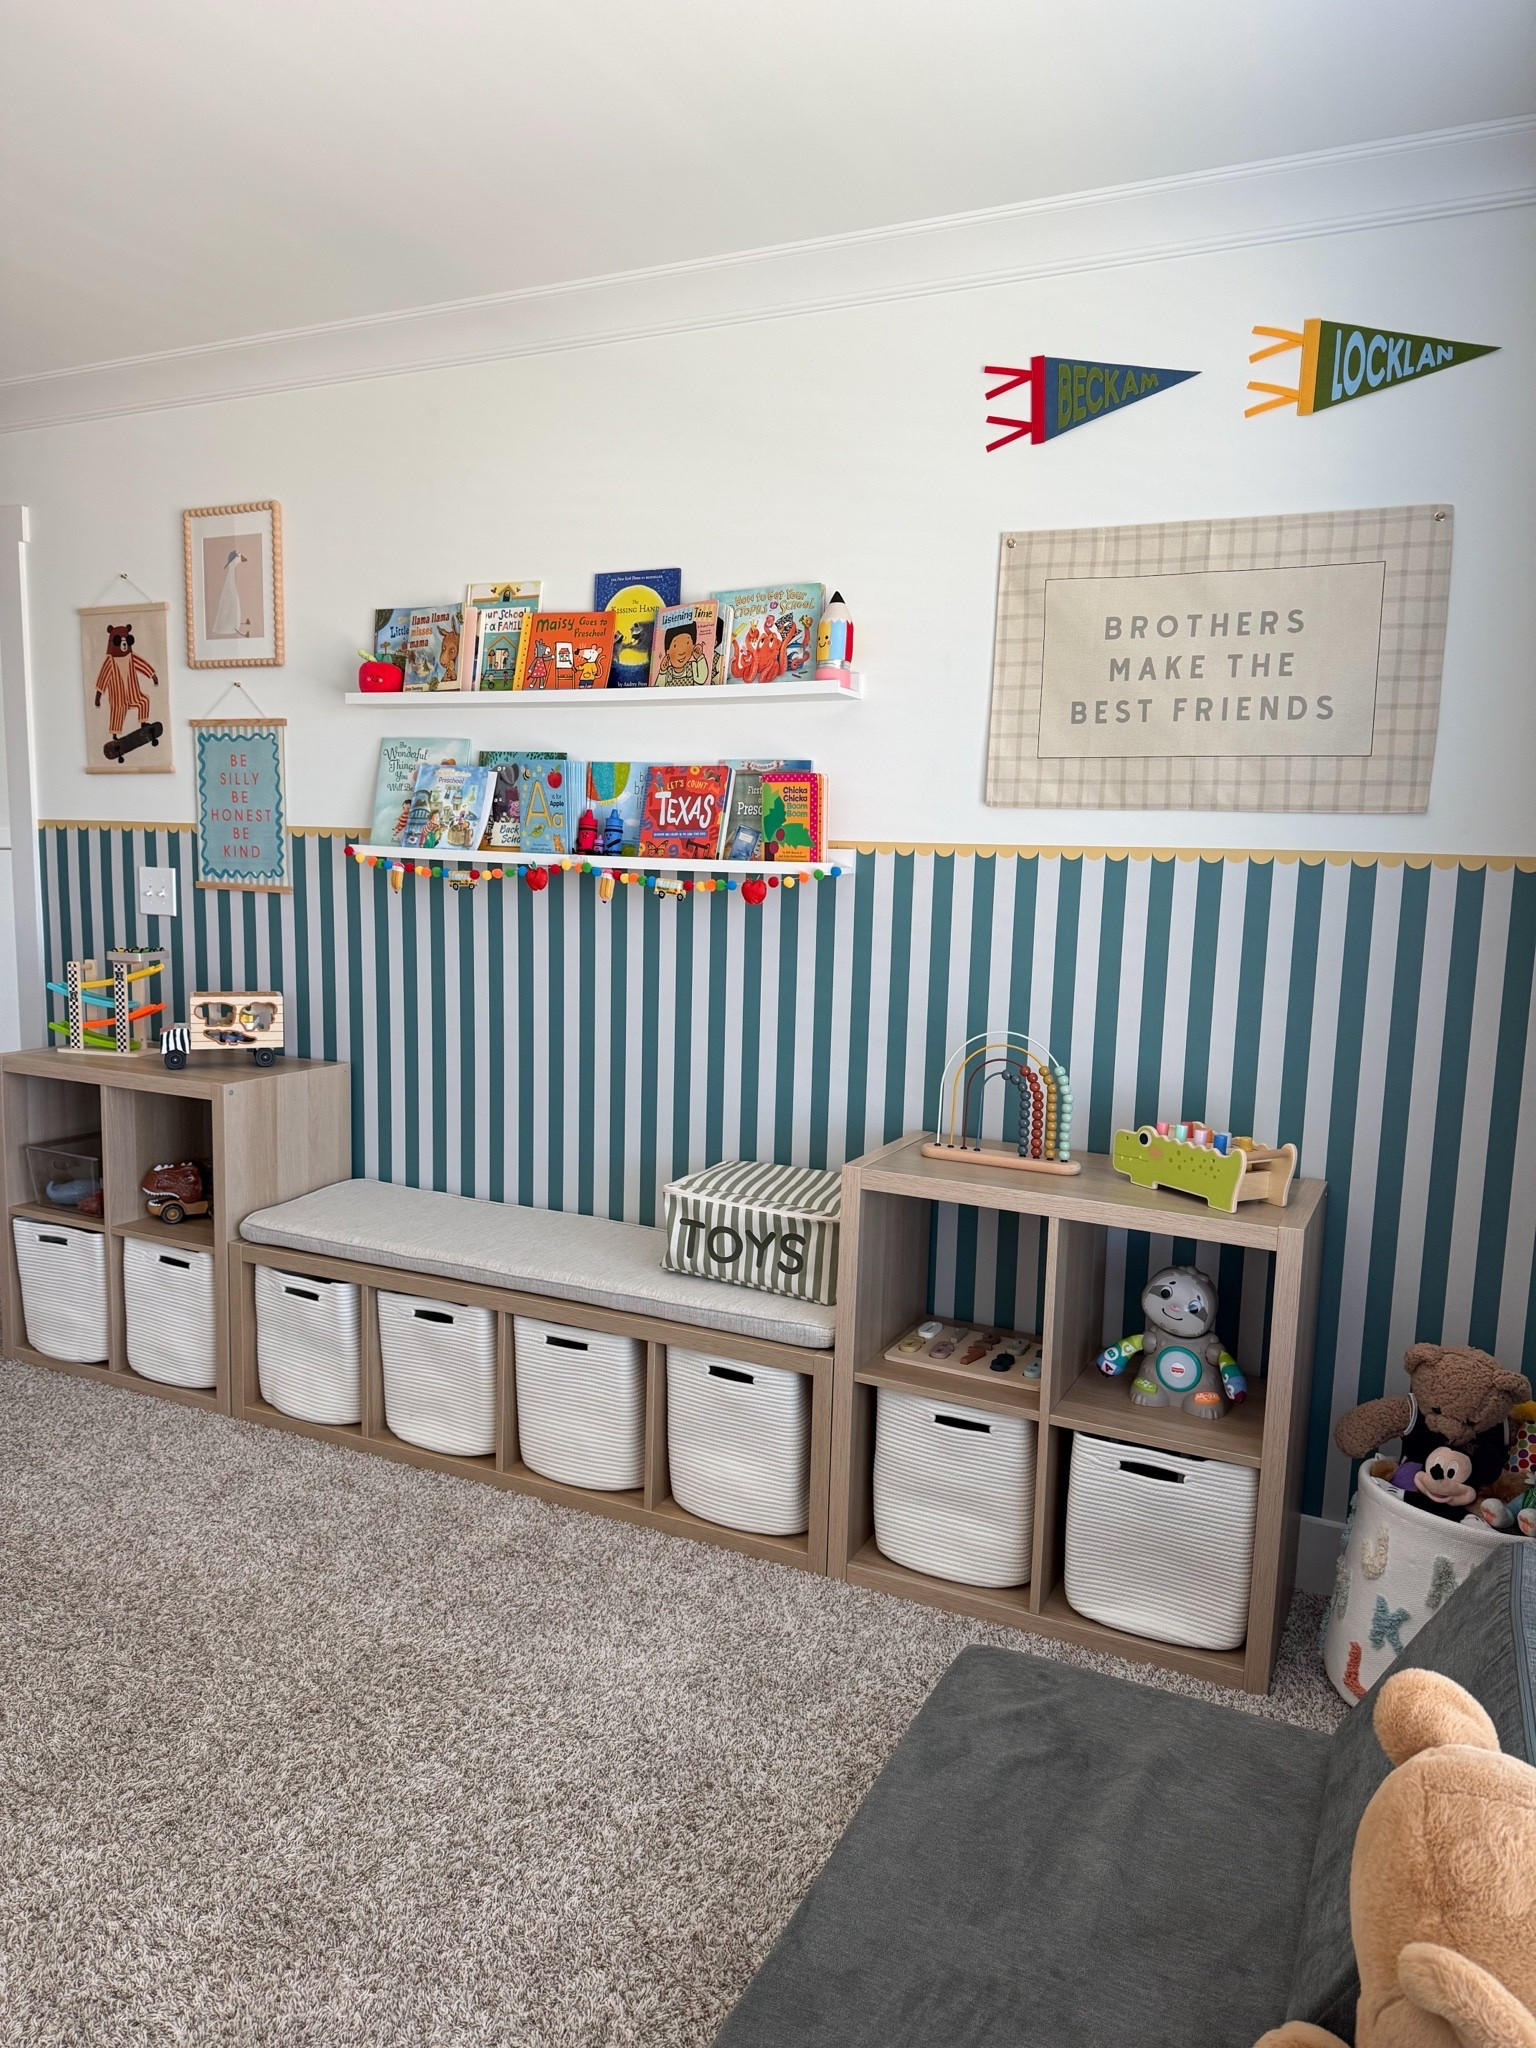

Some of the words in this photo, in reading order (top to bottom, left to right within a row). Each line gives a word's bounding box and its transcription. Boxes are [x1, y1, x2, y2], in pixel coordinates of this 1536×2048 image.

[1331, 329, 1454, 401] LOCKLAN
[1058, 363, 1159, 430] BECKAM
[412, 615, 430, 625] llama
[432, 613, 450, 623] llama
[662, 610, 693, 625] Listening
[694, 607, 713, 618] Time
[497, 620, 522, 632] FAMIL
[536, 617, 575, 633] Maisy
[578, 617, 597, 626] Goes
[599, 617, 608, 626] to
[1104, 609, 1305, 640] BROTHERS
[410, 627, 433, 637] misses
[574, 628, 606, 639] Preschool
[409, 639, 429, 648] mama
[1109, 655, 1206, 682] MAKE
[1227, 652, 1295, 679] THE
[1070, 698, 1153, 725] BEST
[1172, 695, 1335, 722] FRIENDS
[383, 746, 429, 761] Wonderful
[230, 754, 247, 767] BE
[389, 759, 416, 773] Things
[220, 772, 260, 786] SILLY
[395, 771, 408, 782] You
[667, 780, 684, 790] LET'S
[687, 780, 709, 789] COUNT
[783, 786, 808, 794] Chicka
[231, 791, 248, 804] BE
[783, 794, 808, 802] Chicka
[210, 808, 271, 822] HONEST
[655, 791, 715, 829] TEXAS
[233, 827, 249, 840] BE
[500, 824, 520, 834] Back
[501, 834, 521, 843] Scho
[223, 845, 261, 858] KIND
[679, 1217, 807, 1275] TOYS
